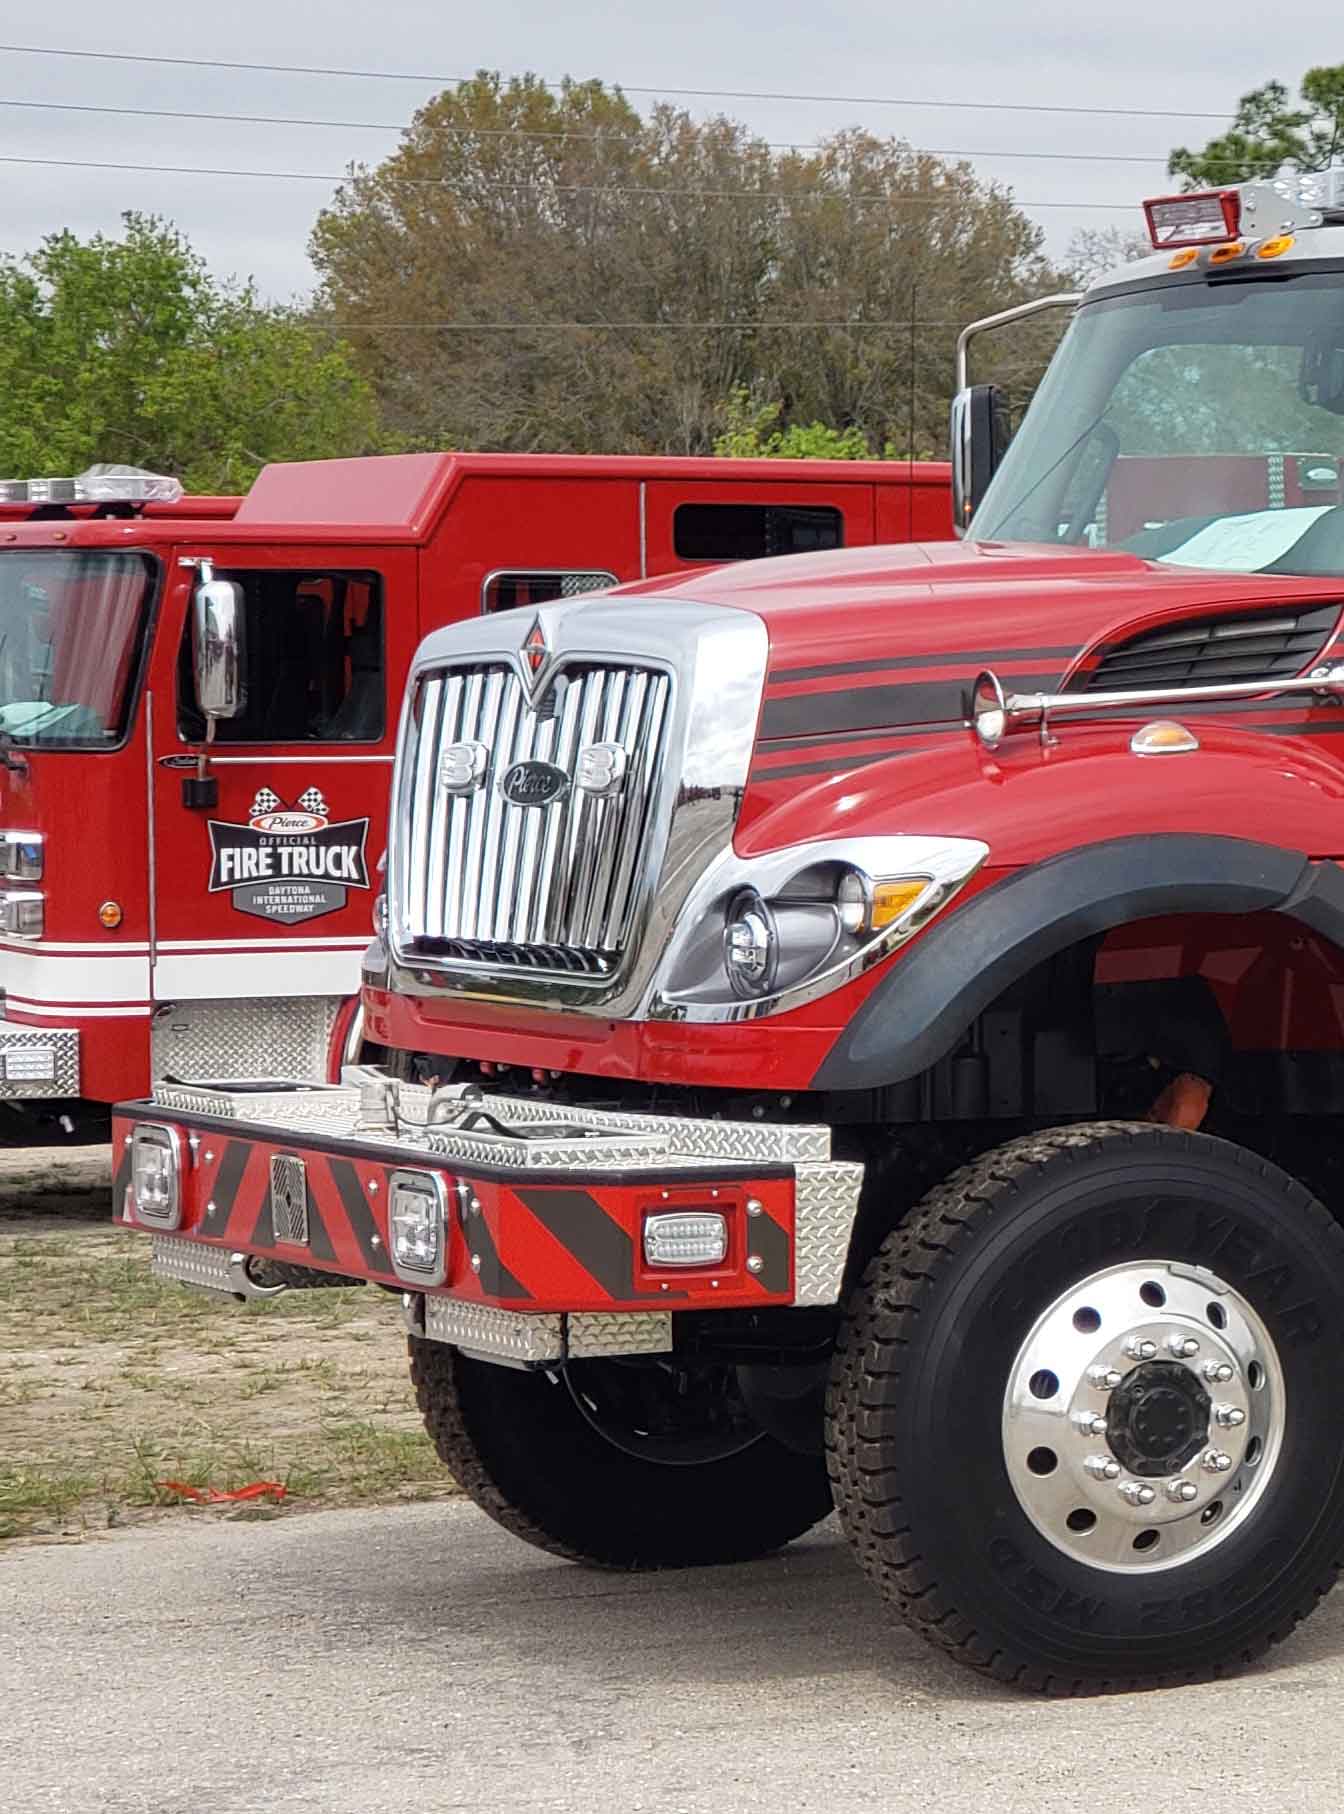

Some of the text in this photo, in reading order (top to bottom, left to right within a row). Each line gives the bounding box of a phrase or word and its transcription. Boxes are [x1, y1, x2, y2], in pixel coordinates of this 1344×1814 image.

[268, 816, 308, 830] Pierce
[259, 836, 317, 846] OFFICIAL
[220, 845, 360, 882] FIRE TRUCK
[268, 885, 311, 895] DAYTONA
[253, 894, 326, 905] INTERNATIONAL
[265, 904, 315, 914] SPEEDWAY
